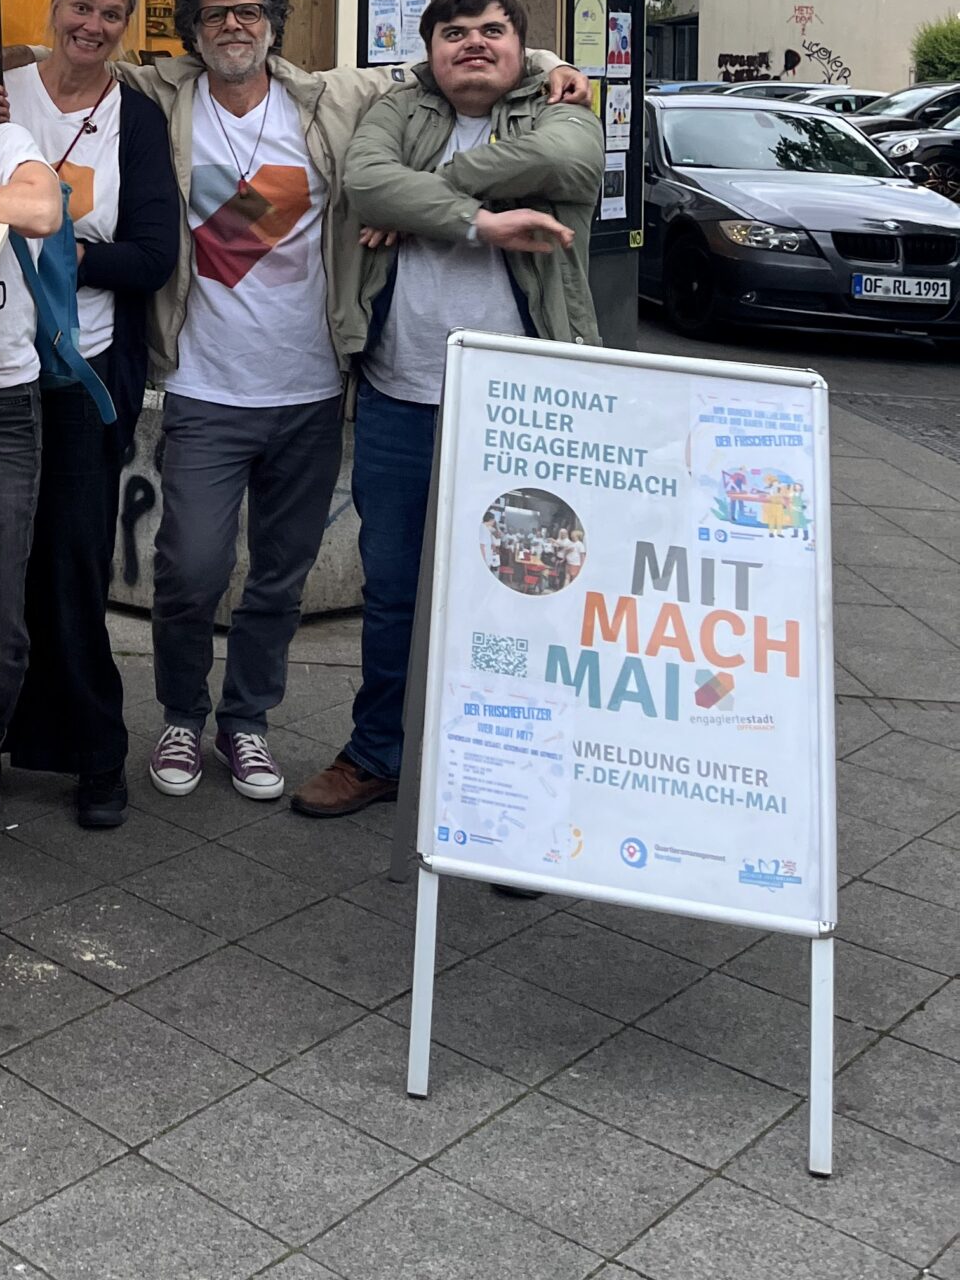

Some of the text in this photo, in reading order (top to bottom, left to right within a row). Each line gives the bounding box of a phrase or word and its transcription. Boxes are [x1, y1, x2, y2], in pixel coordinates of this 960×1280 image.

[864, 277, 948, 297] OF RL 1991
[486, 404, 574, 432] VOLLER
[488, 380, 618, 413] EIN MONAT
[484, 429, 648, 467] ENGAGEMENT
[483, 451, 677, 497] FÜR OFFENBACH
[631, 541, 764, 611] MIT
[580, 591, 800, 678] MACH
[545, 644, 679, 721] MAI
[573, 740, 690, 775] NMELDUNG
[697, 760, 769, 787] UNTER
